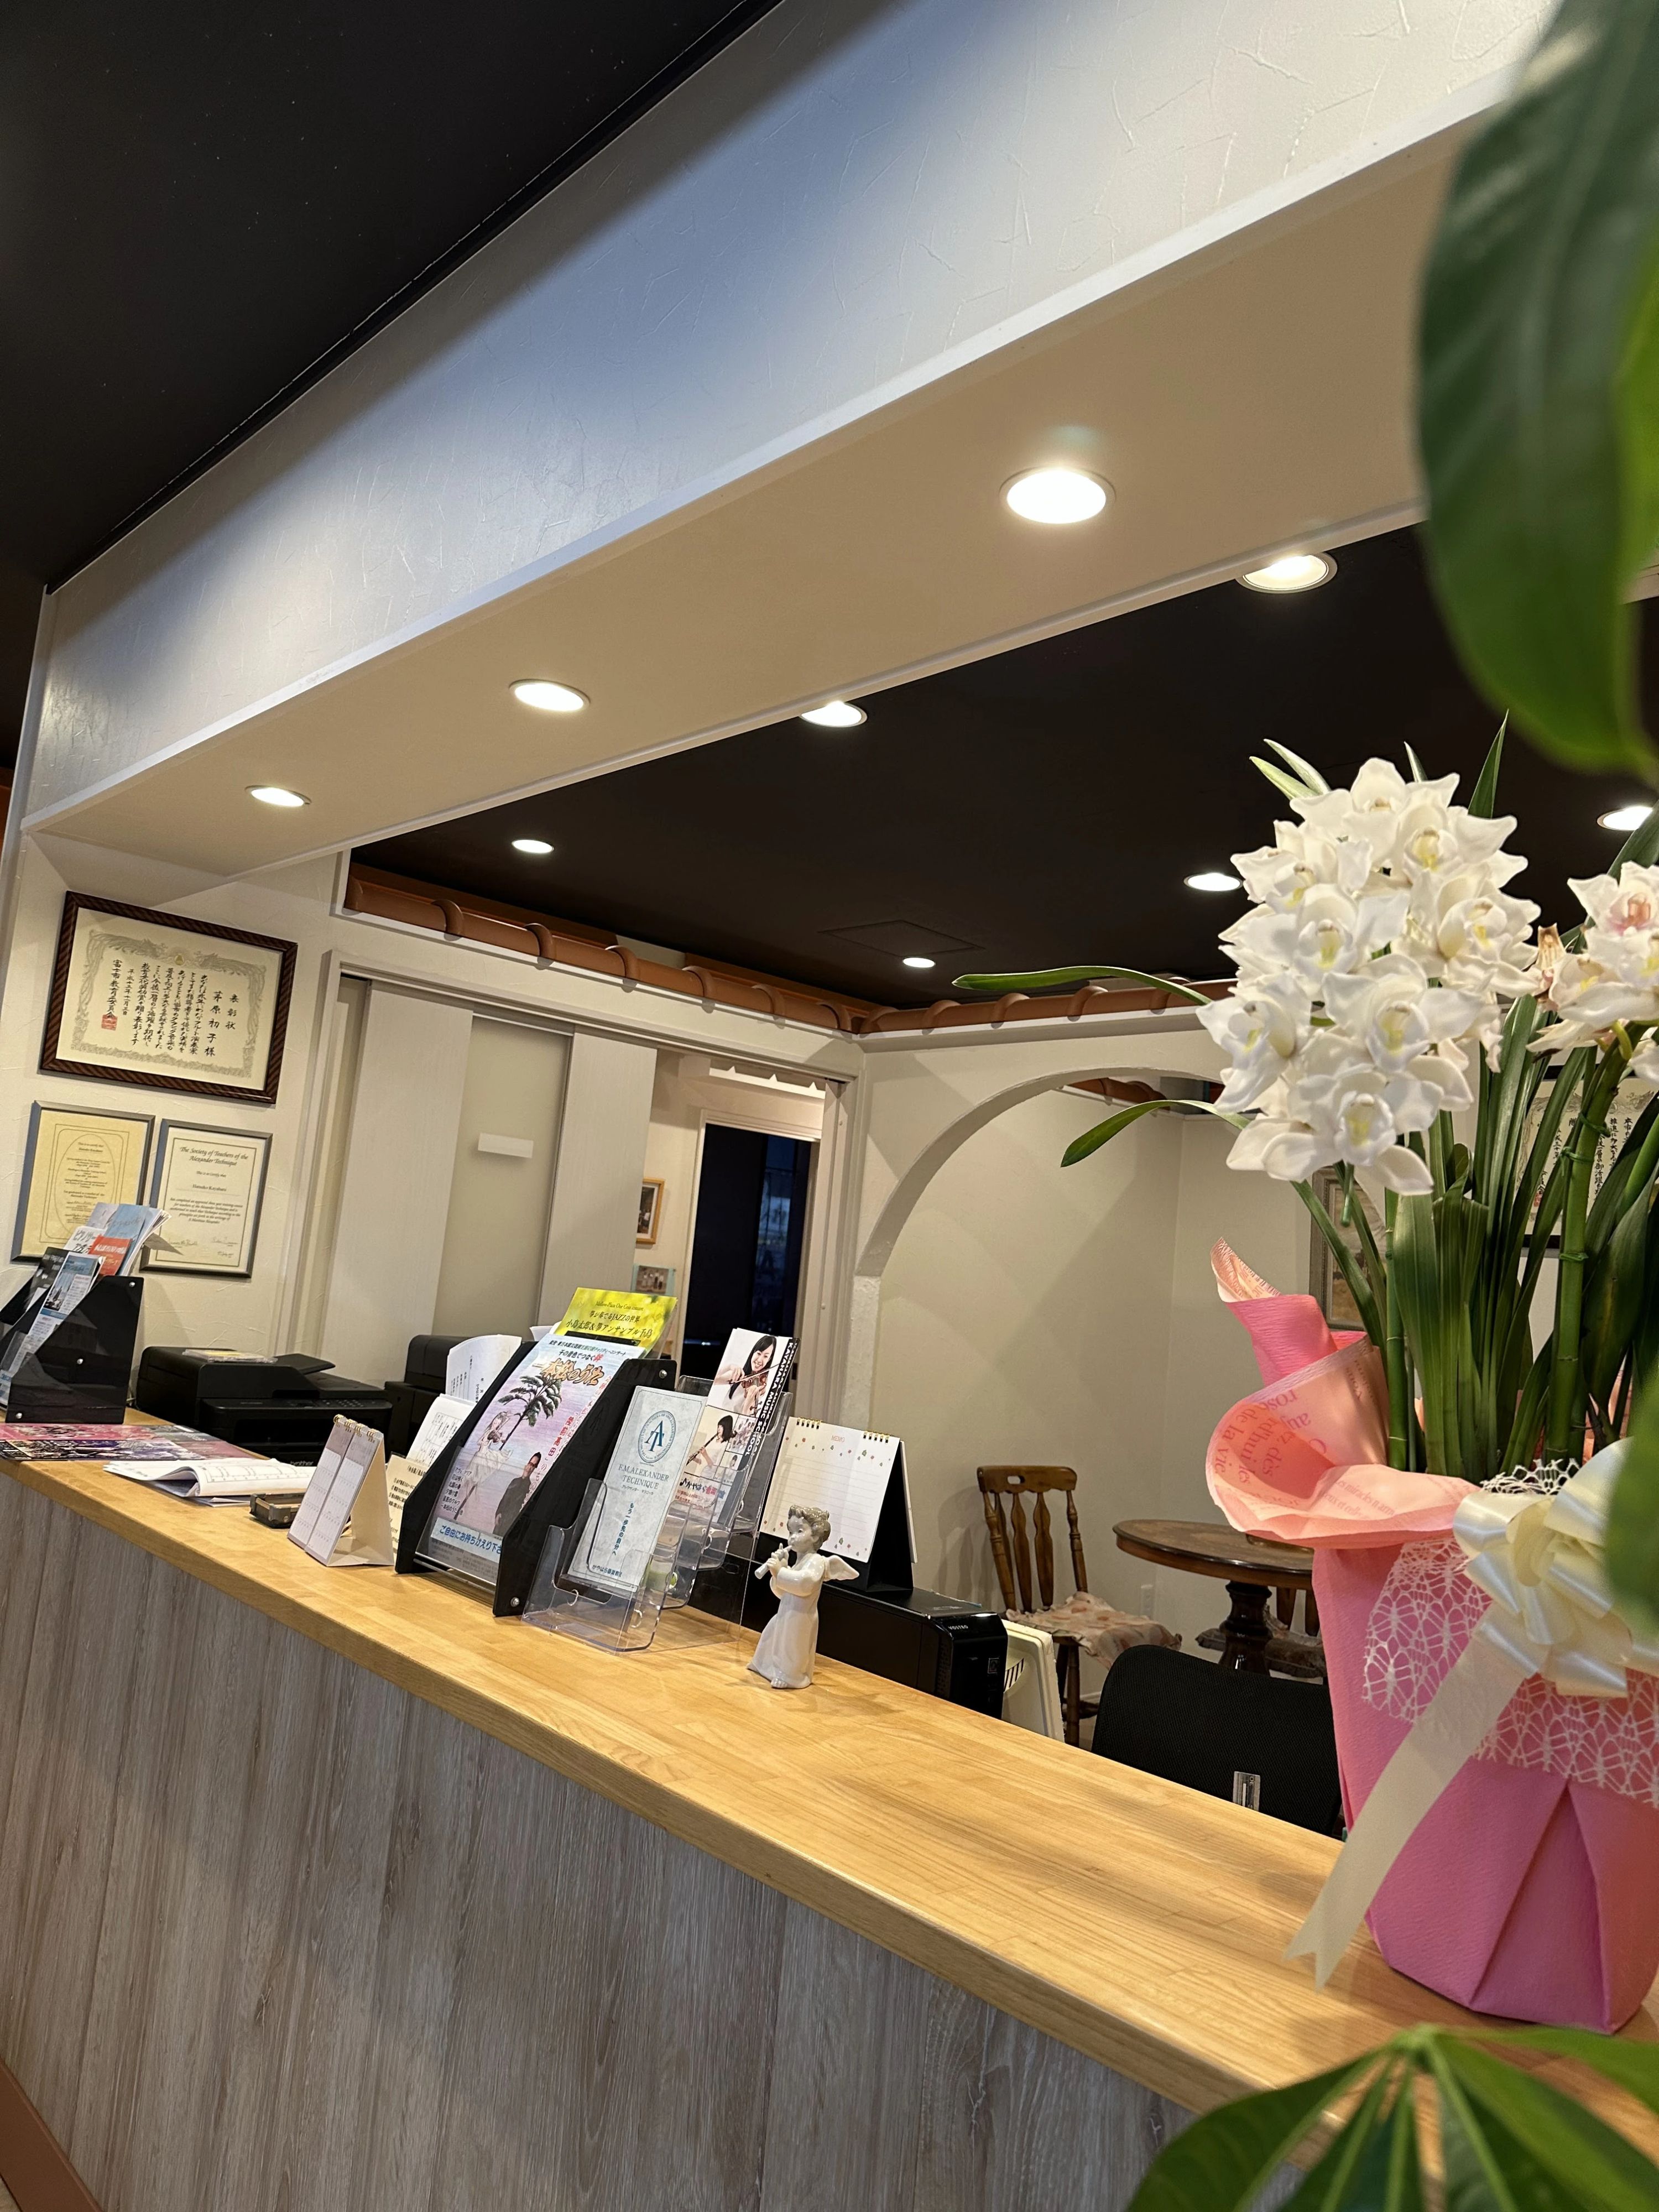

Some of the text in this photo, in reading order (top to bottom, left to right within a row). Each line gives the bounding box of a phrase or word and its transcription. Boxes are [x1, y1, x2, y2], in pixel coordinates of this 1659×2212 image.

[226, 994, 239, 1030] 表彰状
[190, 1148, 207, 1156] Society
[214, 1159, 237, 1167] Technique
[772, 1342, 794, 1390] KAYAHARA
[760, 1391, 775, 1419] MUSIC
[1235, 1408, 1258, 1423] de
[744, 1420, 763, 1457] SCHOOL
[831, 1434, 845, 1443] MEMO
[1222, 1425, 1244, 1441] la
[618, 1464, 669, 1482] F.M.ALEXANDER
[622, 1475, 659, 1490] TECHNIQUE
[612, 1503, 634, 1556] もう一歩先の自分へ
